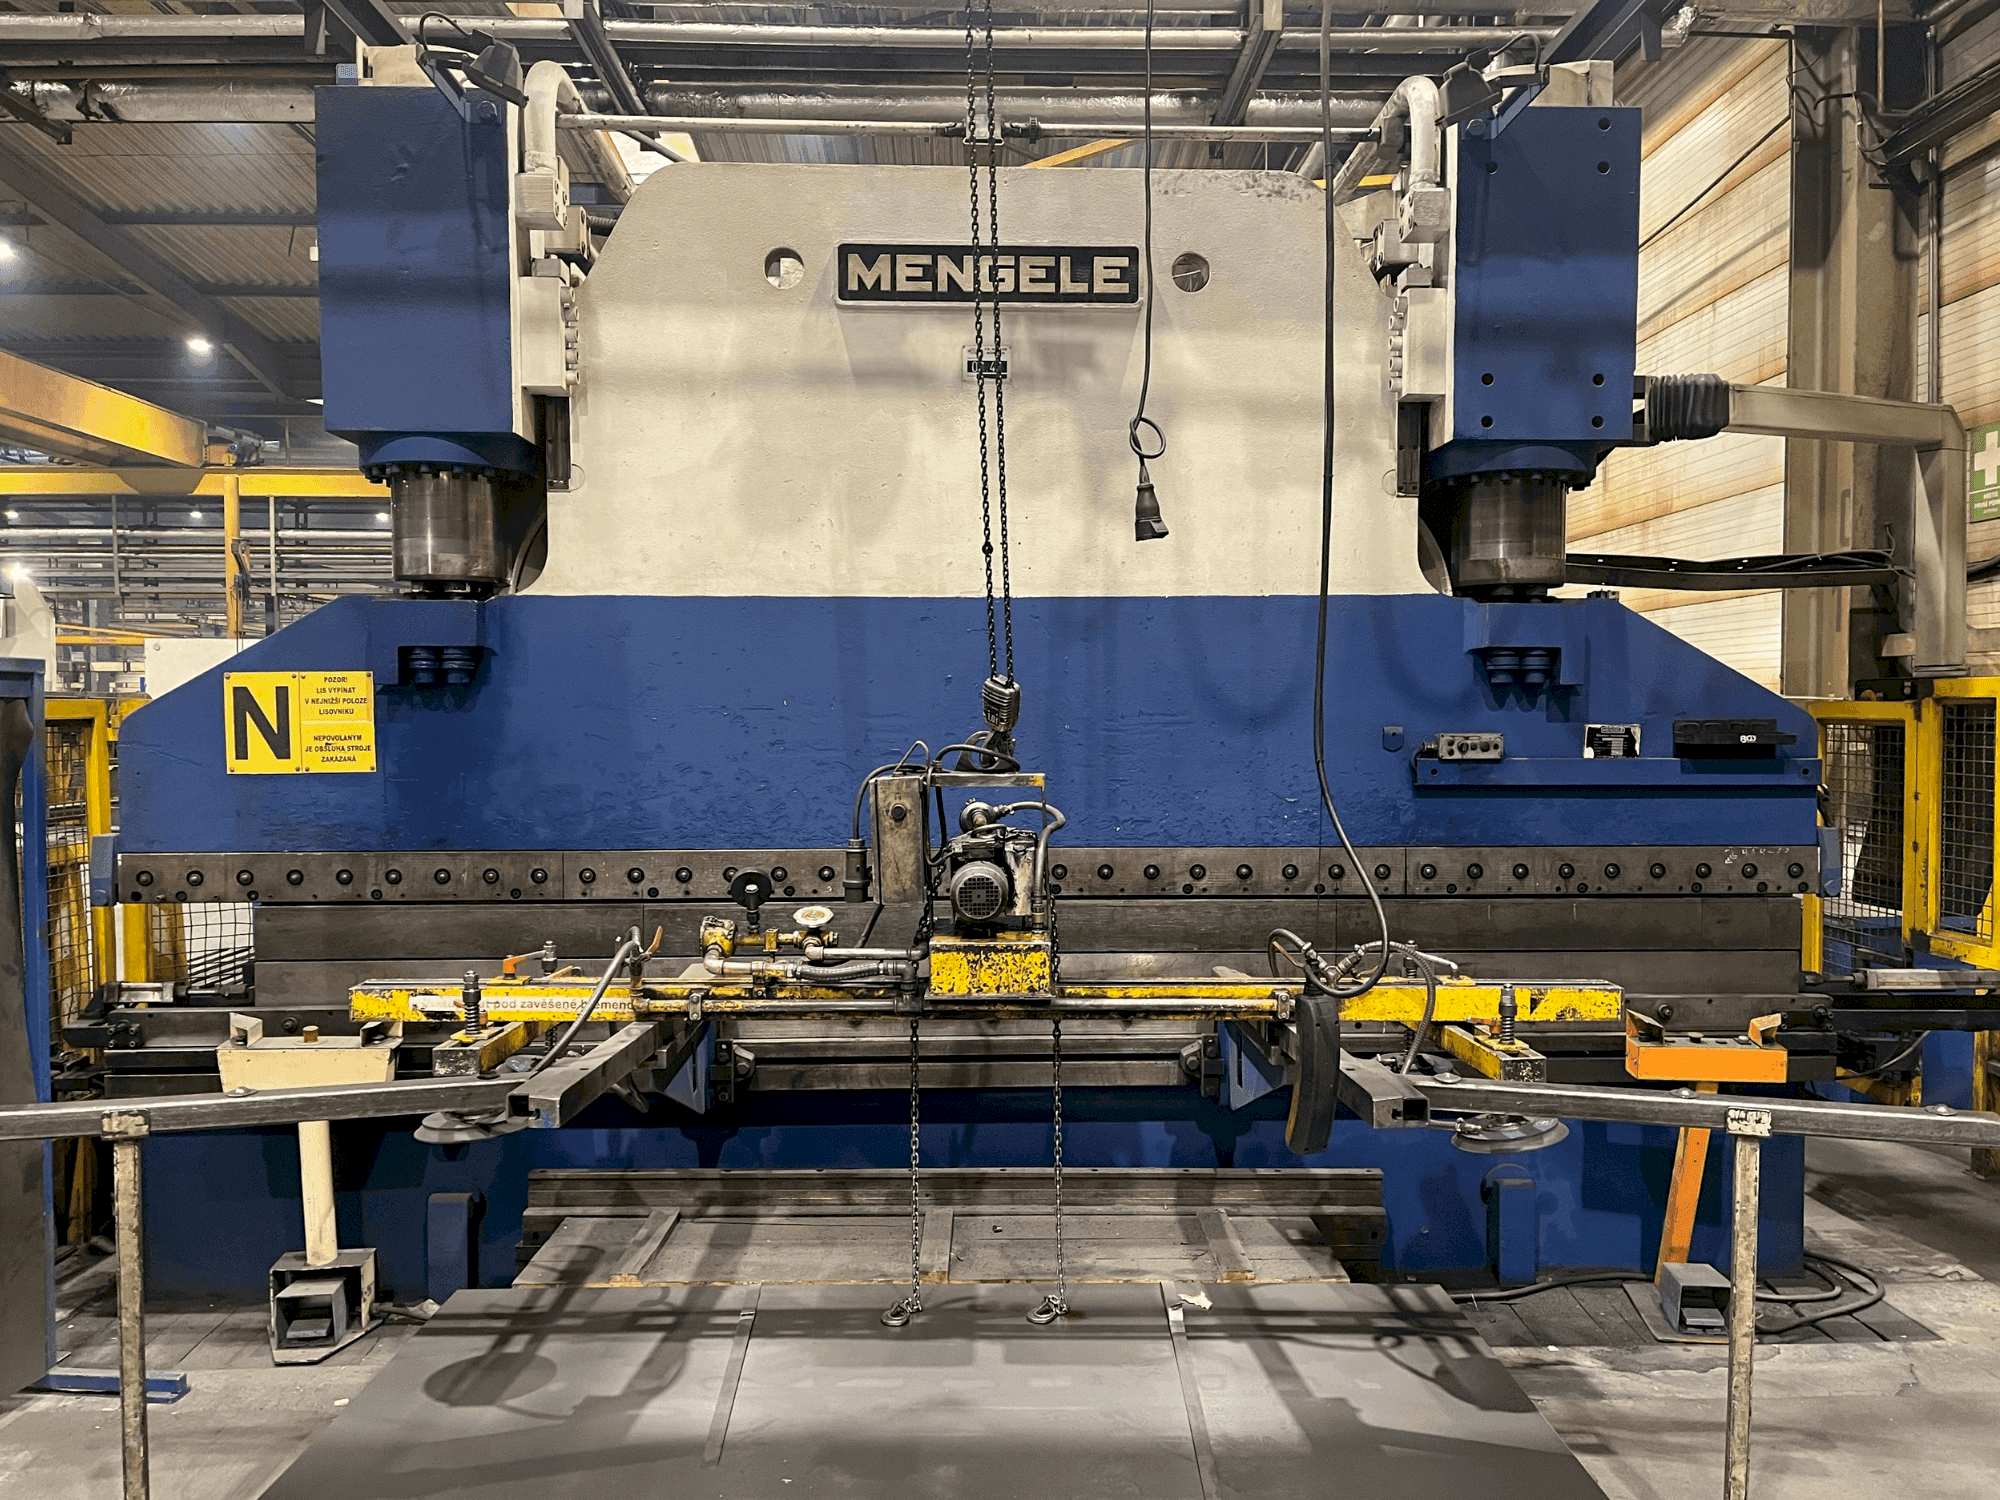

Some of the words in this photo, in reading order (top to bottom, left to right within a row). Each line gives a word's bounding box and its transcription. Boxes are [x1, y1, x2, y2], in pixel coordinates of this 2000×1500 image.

[847, 253, 1130, 294] MENGELE
[232, 686, 291, 760] N
[347, 744, 372, 752] STROJE
[493, 998, 517, 1010] pod
[520, 998, 577, 1010] zavěšené
